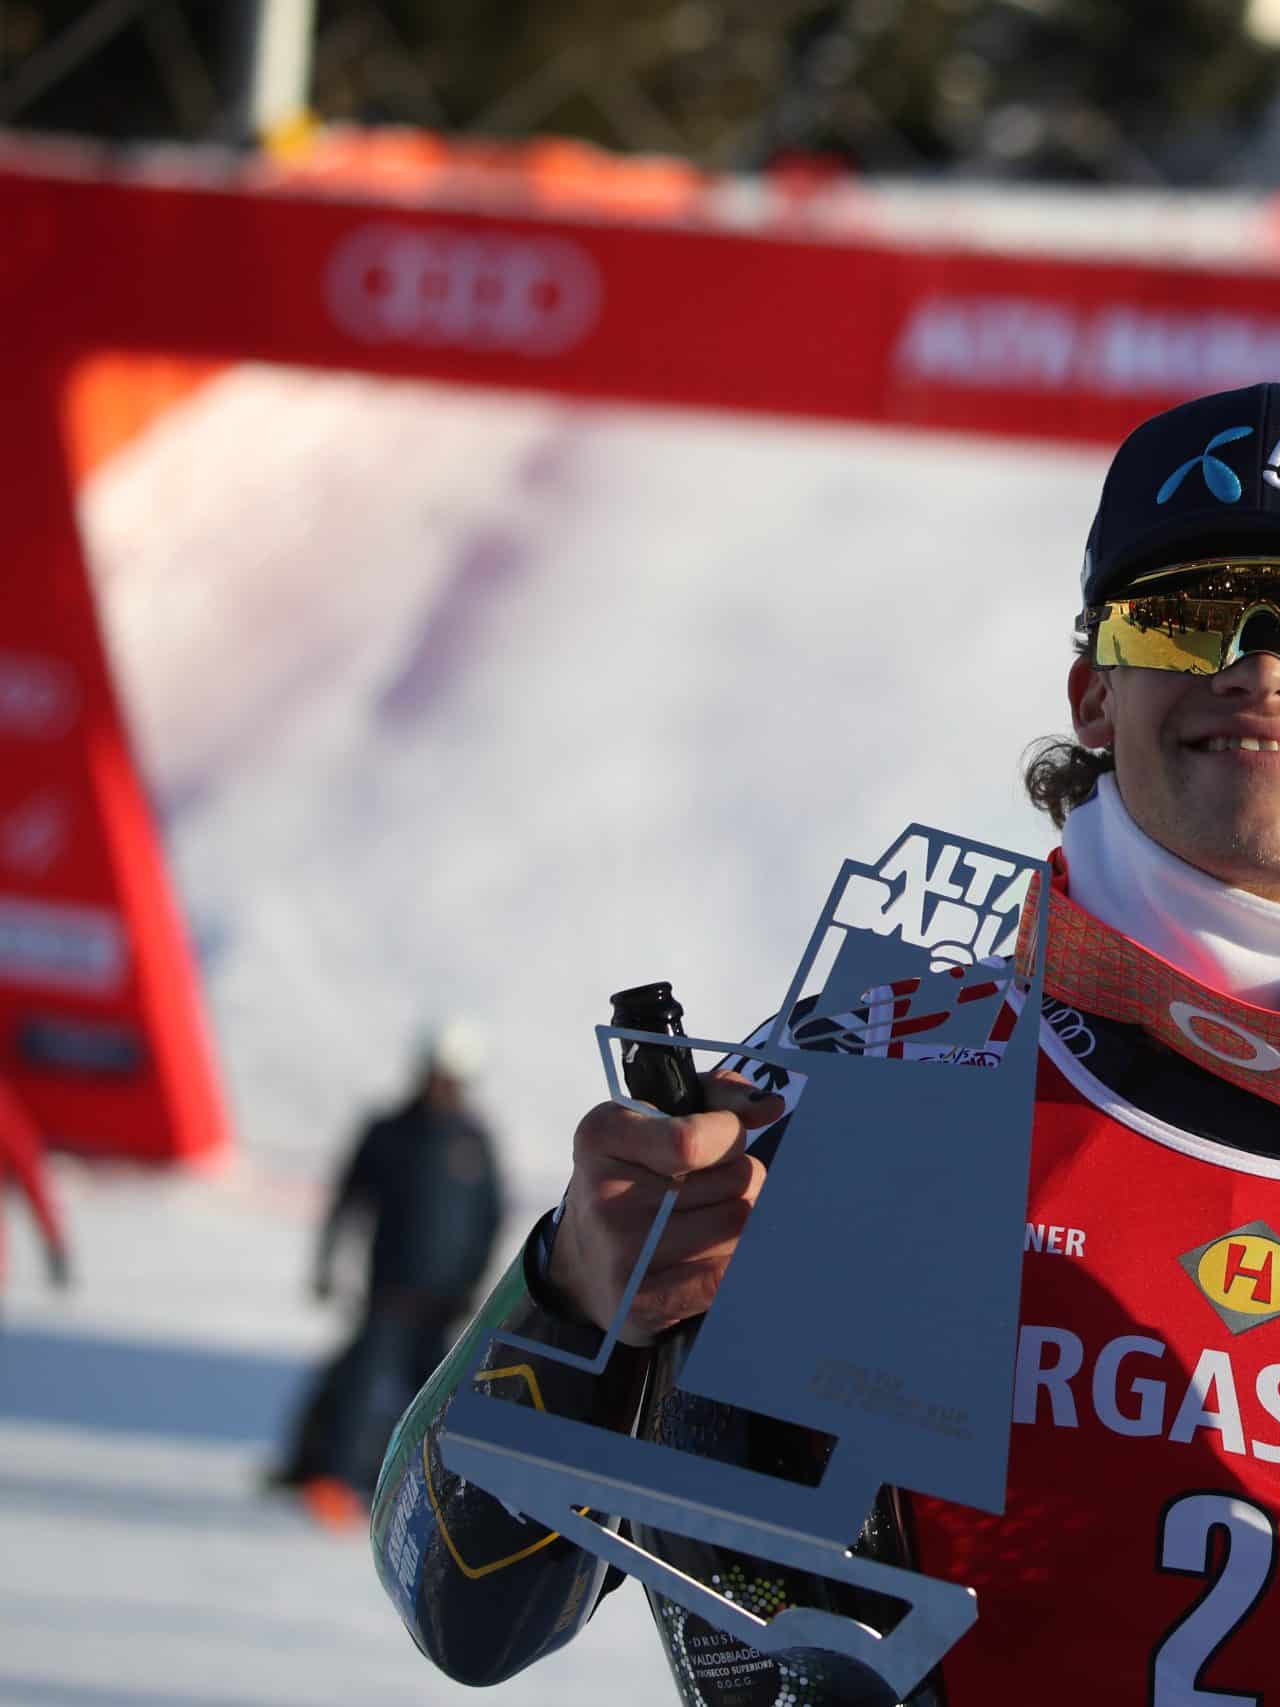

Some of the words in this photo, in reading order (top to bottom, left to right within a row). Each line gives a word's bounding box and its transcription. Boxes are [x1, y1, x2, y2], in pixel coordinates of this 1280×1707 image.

[878, 833, 1042, 915] ALTA
[1223, 1243, 1273, 1305] H
[1149, 1489, 1278, 1707] 2
